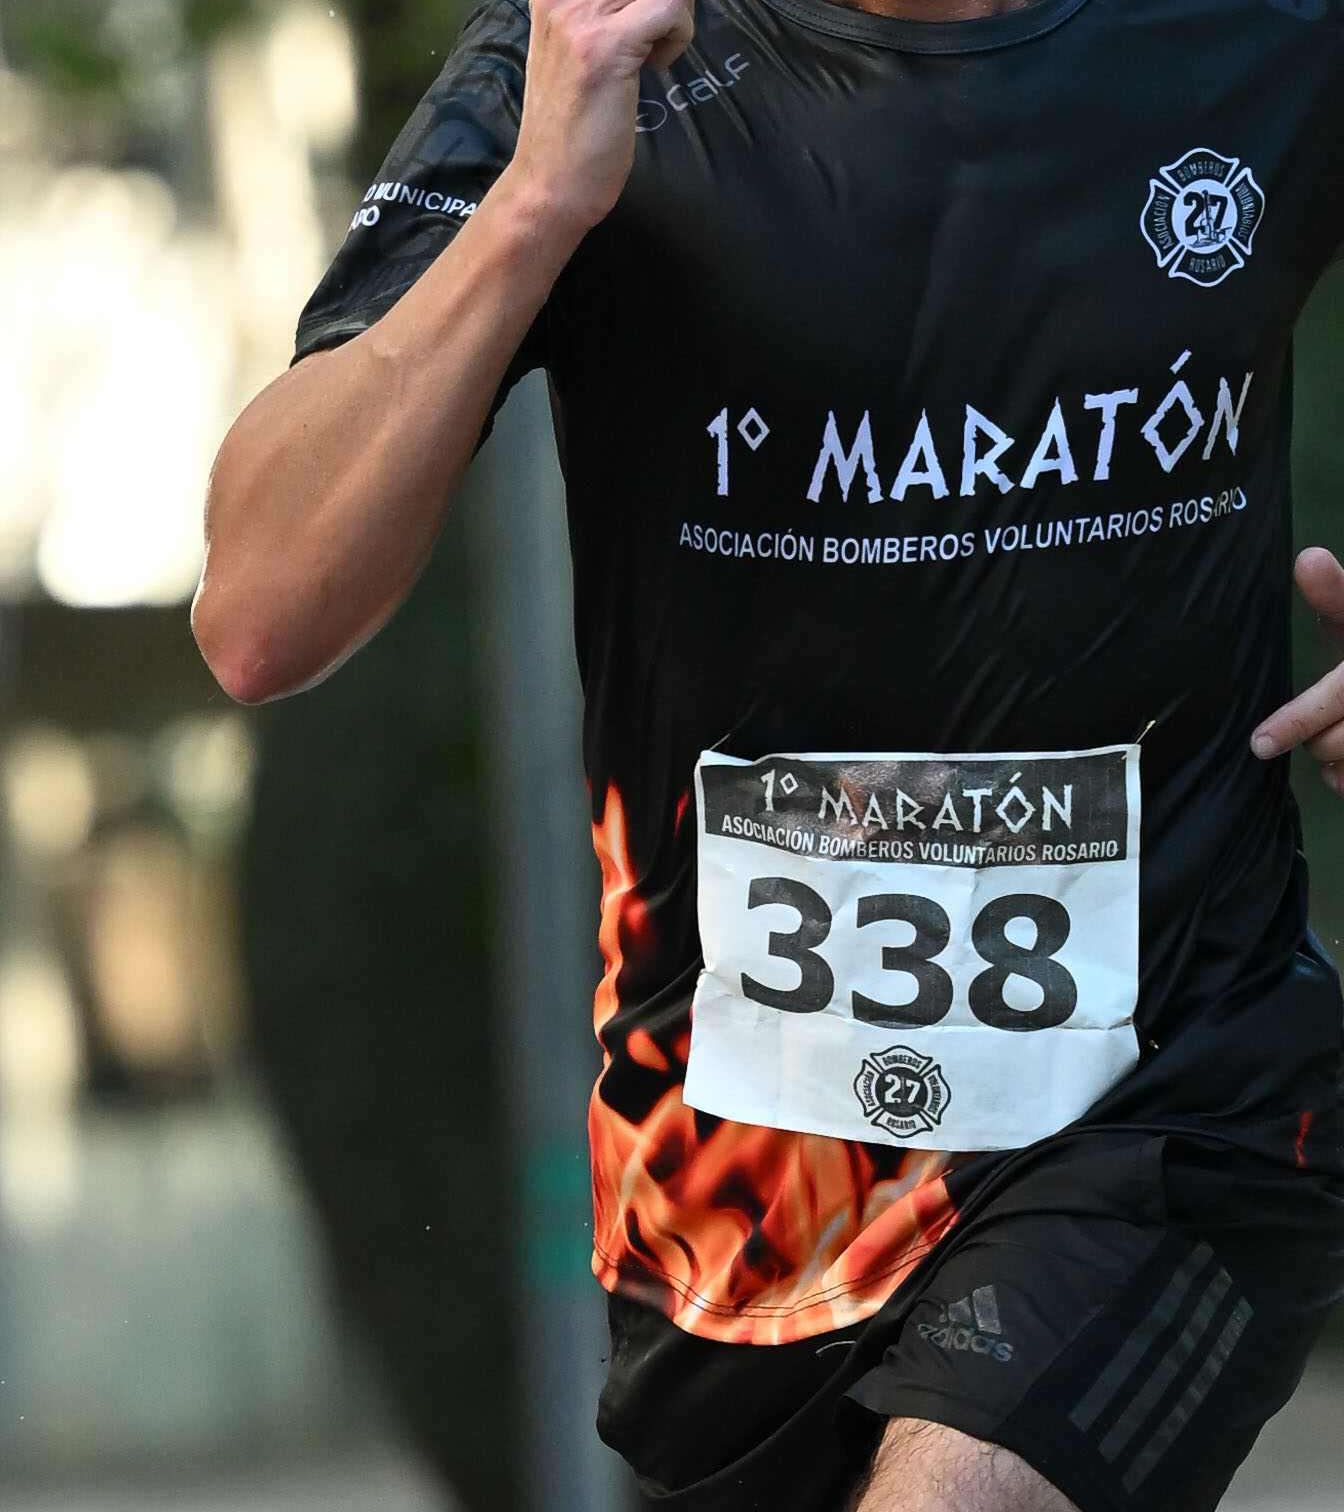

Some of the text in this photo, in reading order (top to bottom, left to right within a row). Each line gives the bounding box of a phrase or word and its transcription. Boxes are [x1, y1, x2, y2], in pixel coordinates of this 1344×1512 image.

[1177, 161, 1226, 182] BOMBEROS
[1184, 191, 1228, 237] 27
[1189, 255, 1226, 274] ROSARIO
[806, 349, 1254, 504] MARATÓN
[679, 522, 815, 562] ASOCIACIÓN
[823, 532, 975, 564] BOMBEROS
[983, 505, 1163, 555] VOLUNTARIOS
[817, 772, 1074, 834] MARATÓN
[721, 814, 1118, 865] ASOCIACIÓN BOMBEROS VOLUNTARIOS ROSARIO
[741, 876, 1078, 1033] 338
[884, 1073, 921, 1104] 27
[918, 1322, 1014, 1363] adidas
